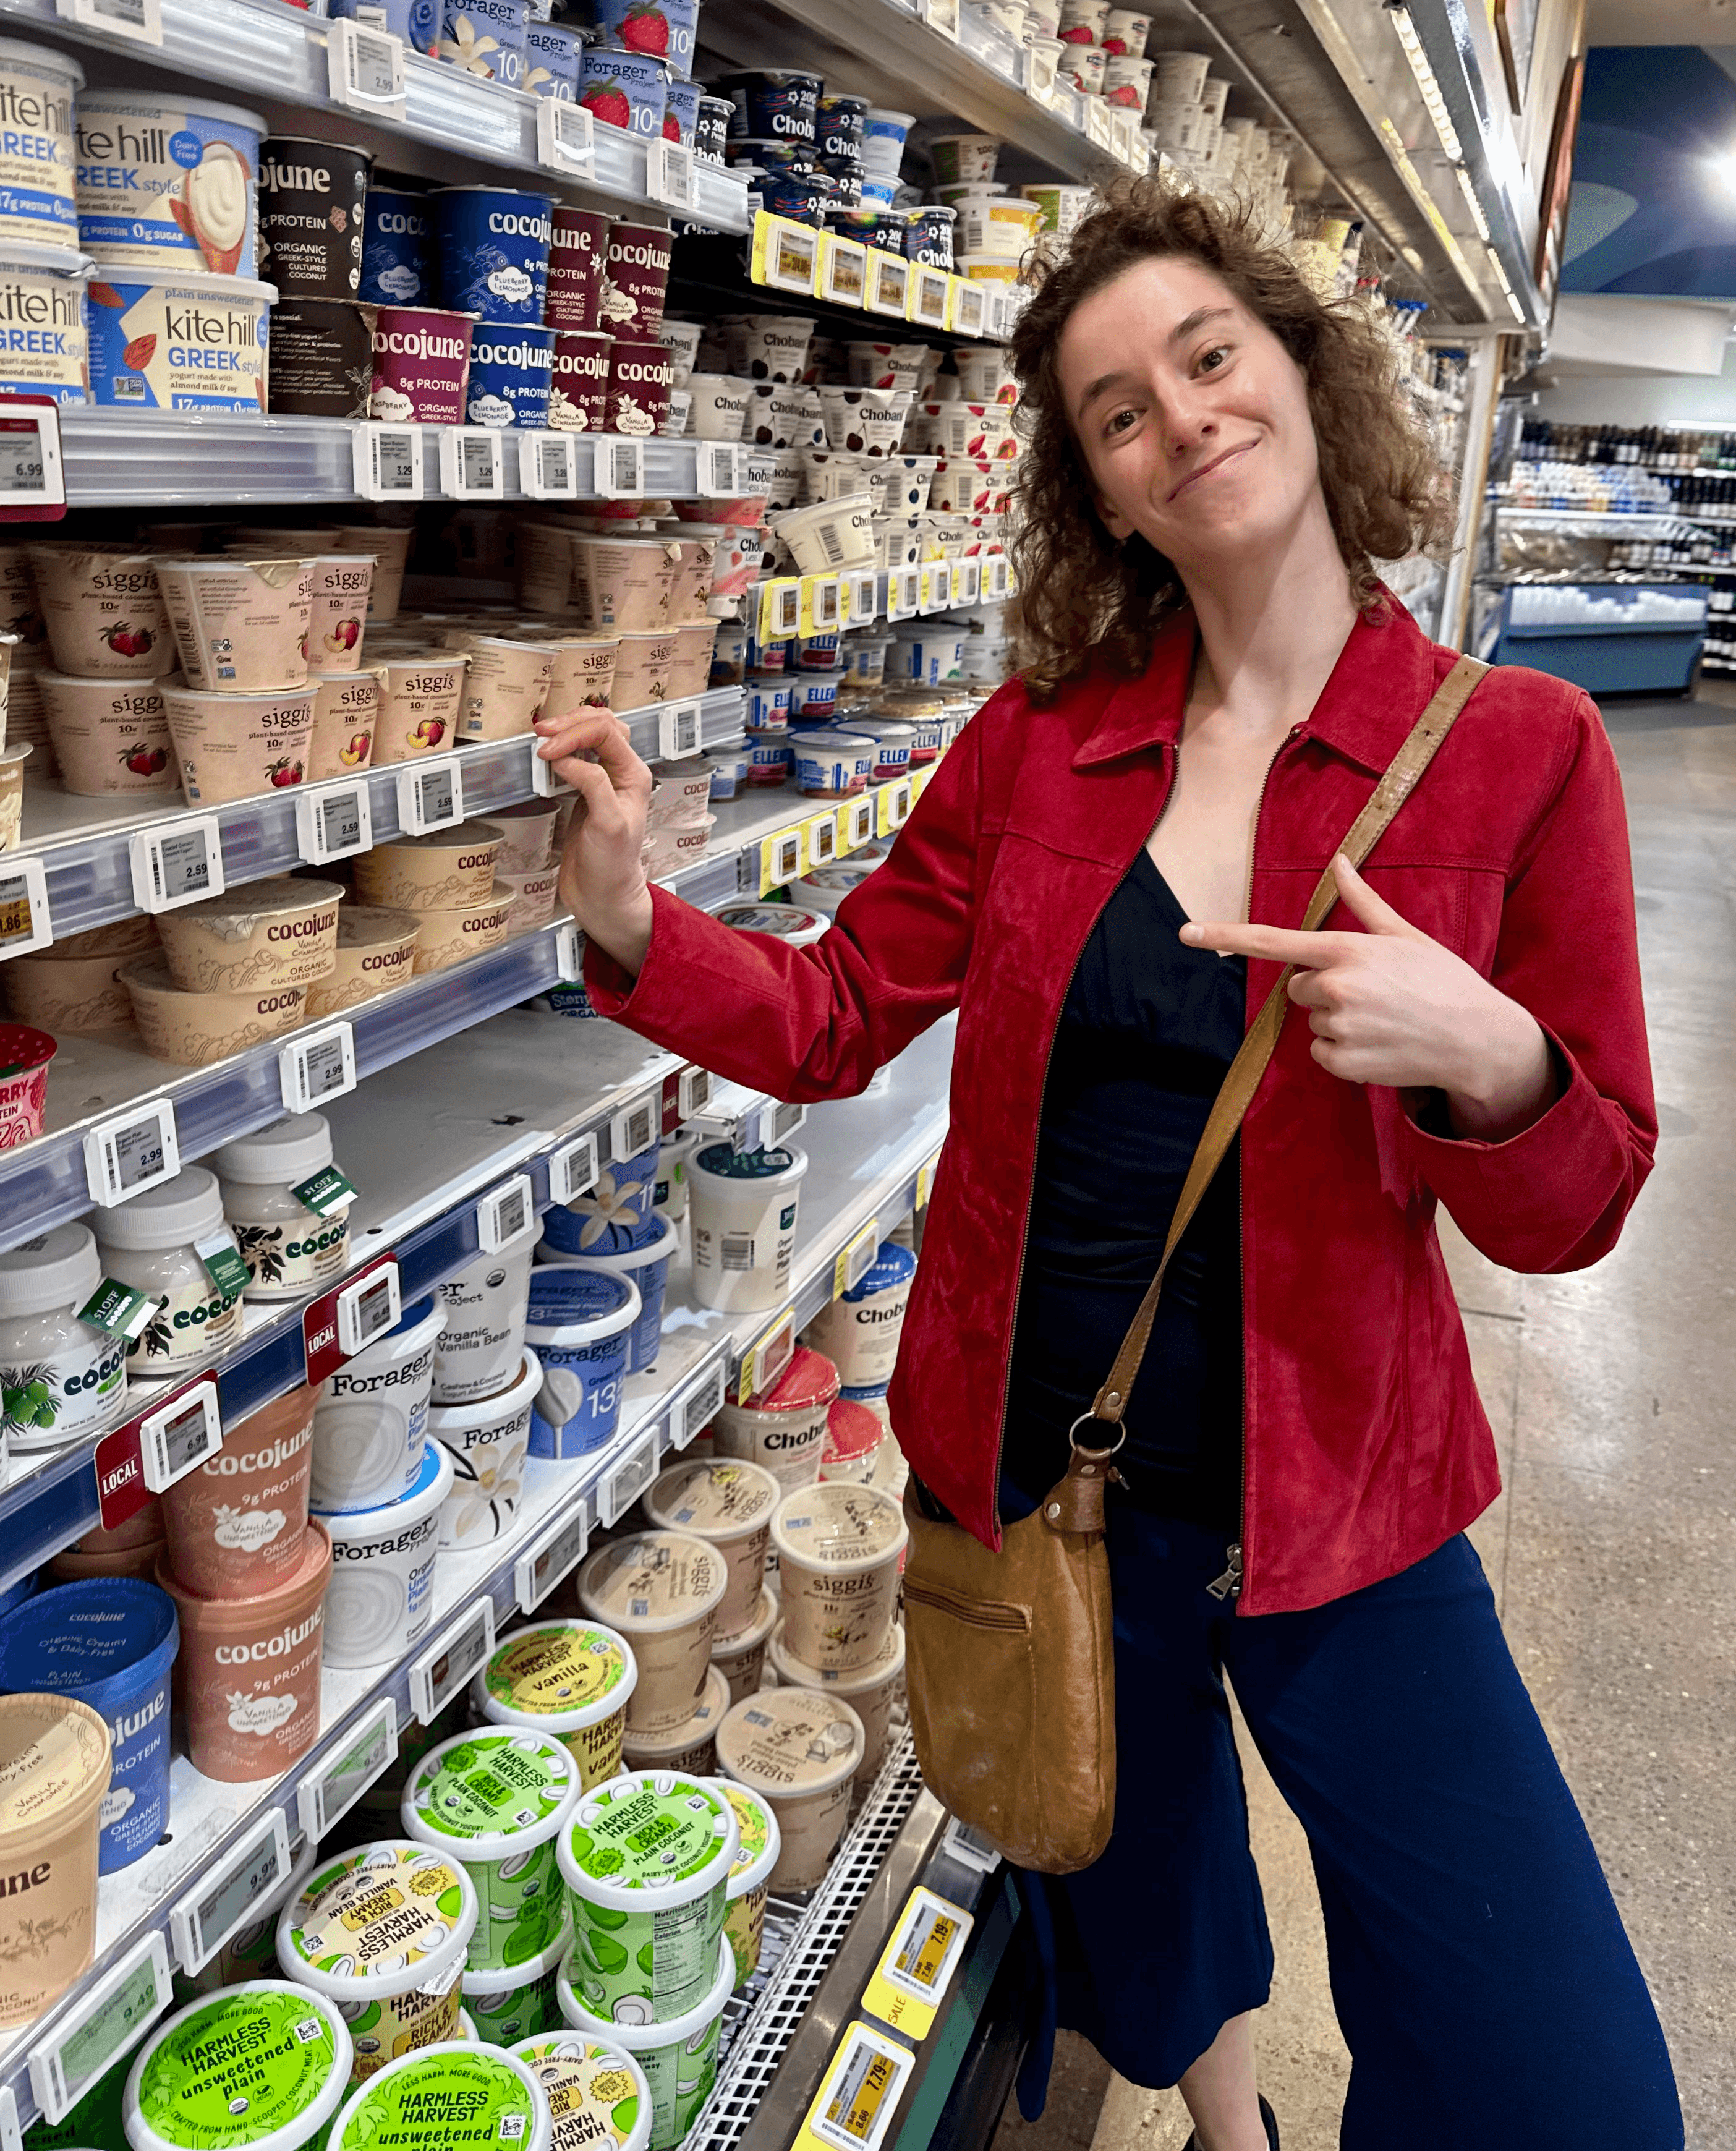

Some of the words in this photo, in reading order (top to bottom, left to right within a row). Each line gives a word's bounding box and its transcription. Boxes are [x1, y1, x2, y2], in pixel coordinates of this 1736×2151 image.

[670, 28, 689, 54] 10
[498, 51, 518, 81] 10
[584, 57, 648, 79] Forager
[376, 76, 392, 91] 2.99
[631, 106, 653, 132] 10
[118, 125, 164, 164] hill
[174, 140, 197, 151] Dairy
[143, 180, 180, 195] style
[270, 215, 326, 230] PROTEIN
[153, 230, 183, 242] SUGAR
[274, 242, 326, 255] ORGANIC
[278, 253, 326, 264] GREEK-STYLE
[289, 263, 326, 273] CULTURED
[289, 271, 326, 280] COCONUT
[495, 275, 528, 285] BLUEBERRY
[495, 283, 529, 292] LEMONADE
[165, 289, 194, 299] plain
[197, 292, 254, 306] unsweetened
[547, 290, 585, 301] ORGANIC
[52, 288, 79, 326] hill
[166, 306, 223, 343] kite
[228, 312, 255, 346] hill
[168, 347, 240, 371] GREEK
[242, 360, 260, 376] style
[170, 372, 195, 382] yogurt
[202, 382, 219, 390] milk
[400, 378, 414, 391] 8g
[417, 378, 459, 392] PROTEIN
[419, 403, 457, 414] ORGANIC
[16, 464, 43, 475] 6.99
[397, 466, 412, 476] 3.29
[479, 467, 492, 476] 3.29
[405, 674, 454, 692] siggi's
[249, 731, 287, 739] plant-based
[438, 796, 452, 808] 2.59
[342, 822, 358, 834] 2.59
[187, 863, 207, 878] 2.59
[268, 911, 336, 942] cocojune
[290, 959, 327, 975] ORGANIC
[271, 972, 310, 985] CULTURED
[325, 1065, 343, 1079] 2.99
[140, 1148, 162, 1166] 2.99
[372, 1305, 390, 1321] 10.49
[308, 1326, 335, 1354] LOCAL
[438, 1327, 489, 1342] Organic
[438, 1339, 480, 1352] Vanilla
[484, 1329, 511, 1346] Bean
[536, 1336, 622, 1363] Forager
[331, 1348, 431, 1396] Forager
[587, 1381, 616, 1418] 13
[187, 1431, 208, 1449] 6.99
[202, 1420, 313, 1476] cocojune
[103, 1459, 138, 1494] LOCAL
[242, 1494, 260, 1506] 9g
[263, 1464, 308, 1500] PROTEIN
[232, 1518, 272, 1533] VANILLA
[333, 1516, 432, 1562] Forager
[813, 1575, 874, 1595] siggi's
[69, 1612, 126, 1622] cocojune
[38, 1635, 83, 1647] Organic
[86, 1637, 127, 1646] Creamy
[215, 1604, 322, 1664] cocojune
[510, 1641, 571, 1672] HARMLESS
[521, 1650, 572, 1677] HARVEST
[48, 1671, 82, 1679] PLAIN
[253, 1680, 271, 1692] 9g
[274, 1646, 318, 1687] PROTEIN
[532, 1662, 589, 1691] vanilla
[245, 1703, 284, 1718] VANILLA
[489, 1757, 534, 1790] HARVEST
[497, 1748, 548, 1786] HARMLESS
[738, 1753, 796, 1783] siggi's
[15, 1780, 56, 1808] VANILLA
[470, 1779, 501, 1807] CREAMY
[481, 1774, 501, 1793] RICH
[497, 1786, 507, 1796] &
[17, 1778, 69, 1818] CHAMOMILE
[448, 1777, 467, 1794] PLAIN
[466, 1792, 499, 1818] COCONUT
[110, 1797, 161, 1836] ORGANIC
[593, 1793, 655, 1835] HARMLESS
[606, 1803, 658, 1839] HARVEST
[634, 1824, 655, 1842] RICH
[653, 1820, 666, 1830] &
[639, 1823, 674, 1849] CREAMY
[633, 1847, 659, 1865] PLAIN
[658, 1821, 696, 1849] COCONUT
[642, 1867, 679, 1878] DAIRY-FREE
[680, 1850, 702, 1868] COCONUT
[700, 1830, 712, 1854] YOGURT
[249, 1855, 277, 1891] 9.99
[357, 1863, 396, 1875] DAIRY-FREE
[358, 1877, 398, 1901] VANILLA
[328, 1898, 355, 1919] BEAN
[349, 1891, 391, 1920] CREAMY
[369, 1902, 393, 1920] RICH
[654, 1905, 687, 1919] Nutrition
[357, 1906, 422, 1949] HARVEST
[358, 1915, 368, 1923] &
[358, 1912, 435, 1961] HARMLESS
[653, 1930, 681, 1940] Calories
[930, 1923, 948, 1944] 7.19
[921, 1961, 934, 1977] 7.99
[124, 1984, 155, 2019] 9.49
[888, 1995, 906, 2024] SALE
[410, 2016, 441, 2042] RICH
[441, 2005, 451, 2021] &
[181, 2016, 272, 2067] HARMLESS
[192, 2032, 267, 2076] HARVEST
[181, 2036, 296, 2100] unsweetened
[866, 2064, 887, 2091] 7.79
[223, 2067, 266, 2101] plain
[401, 2077, 420, 2091] LESS
[449, 2069, 471, 2079] MORE
[170, 2110, 198, 2131] CRAFTED
[199, 2124, 223, 2134] FROM
[224, 2098, 286, 2134] HAND-SCOOPED
[286, 2069, 310, 2101] COCONUT
[303, 2050, 313, 2068] MEAT
[399, 2091, 489, 2109] HARMLESS
[401, 2106, 479, 2124] HARVEST
[856, 2109, 869, 2129] 8.66
[379, 2123, 494, 2145] unsweetened
